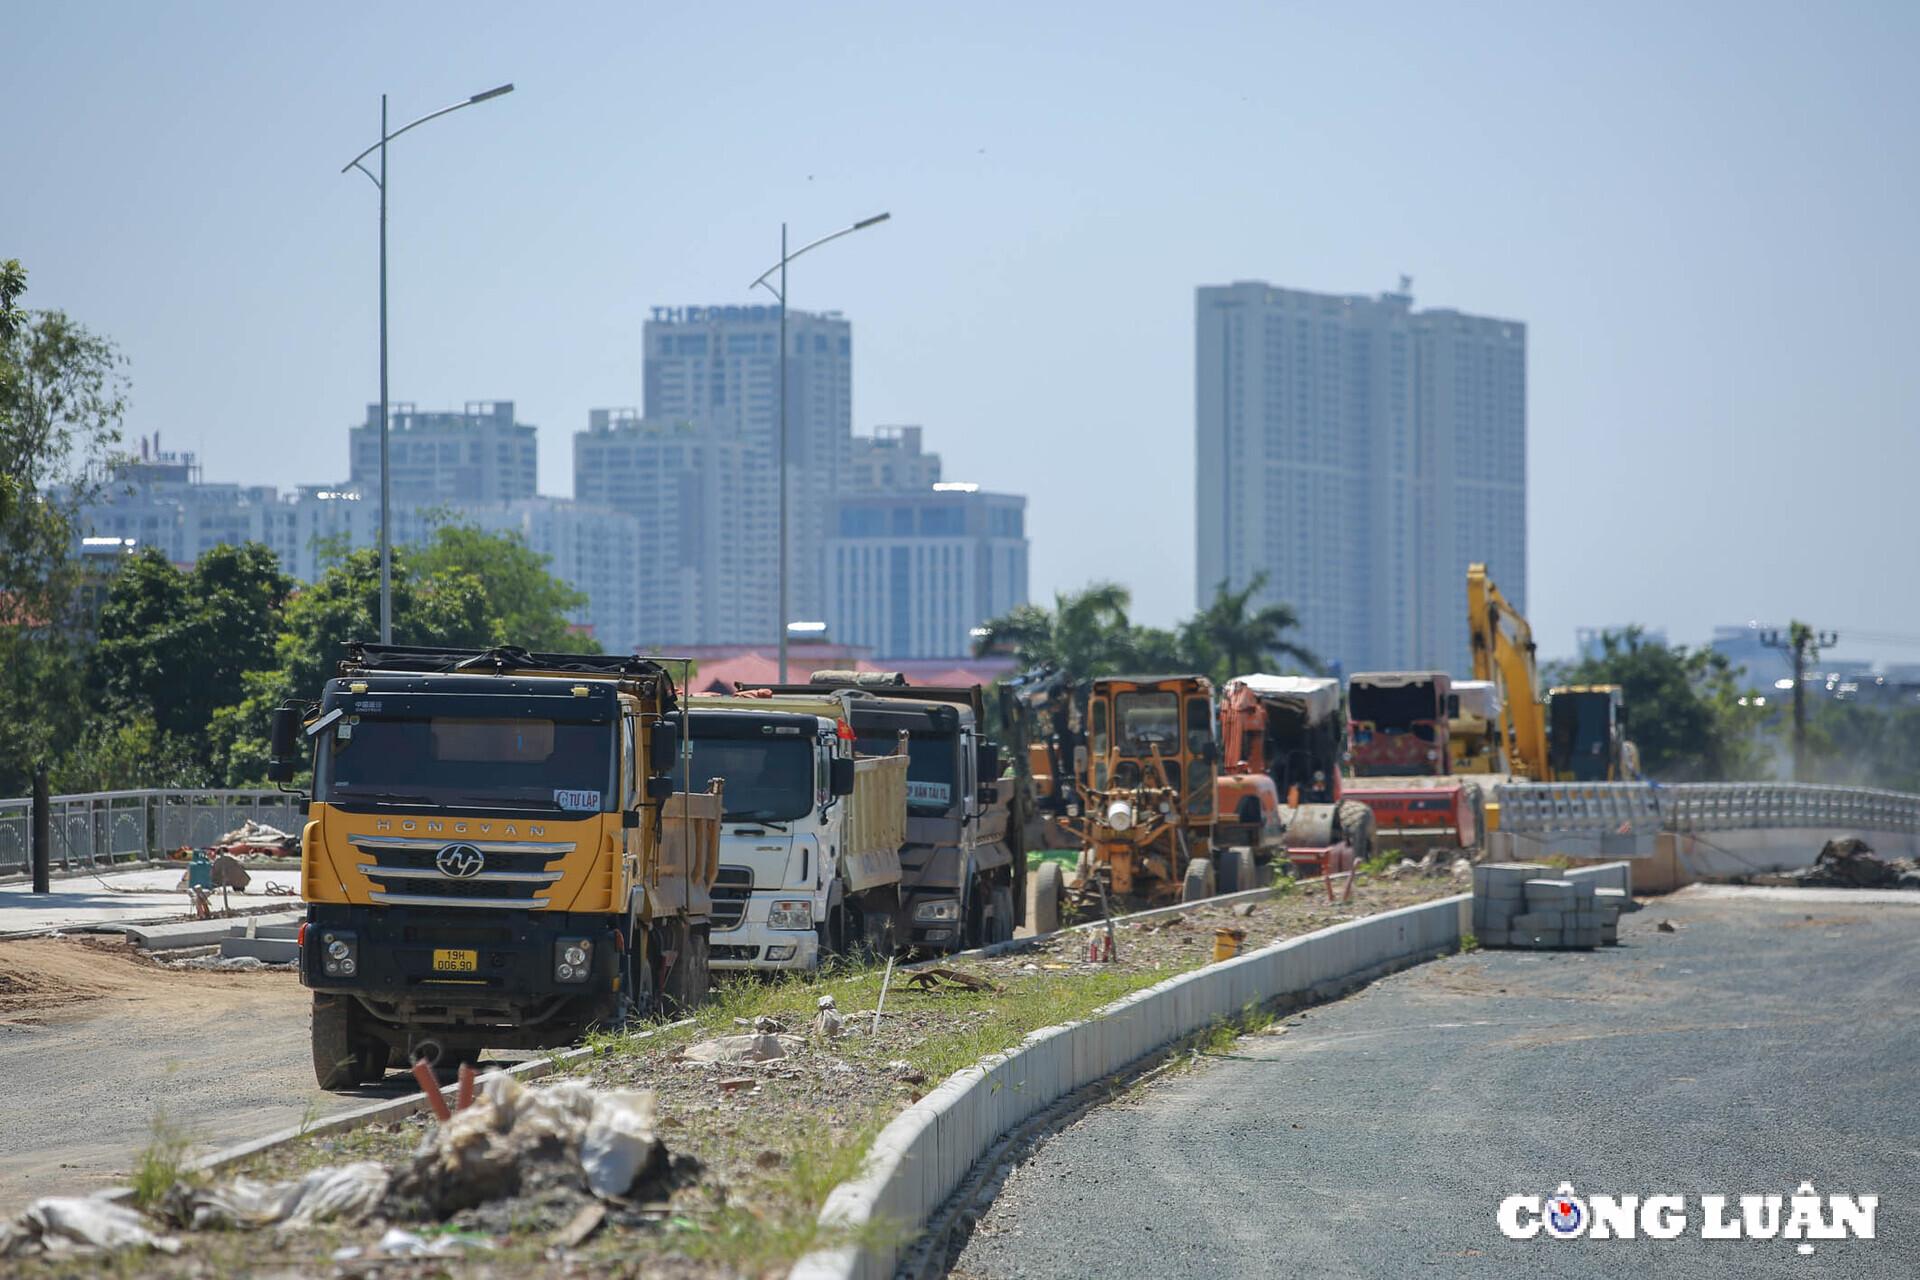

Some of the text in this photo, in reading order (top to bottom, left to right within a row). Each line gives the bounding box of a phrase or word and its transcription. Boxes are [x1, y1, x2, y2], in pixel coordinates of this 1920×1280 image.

[650, 305, 704, 324] THE
[447, 950, 465, 960] 19H
[438, 960, 472, 971] 006.90
